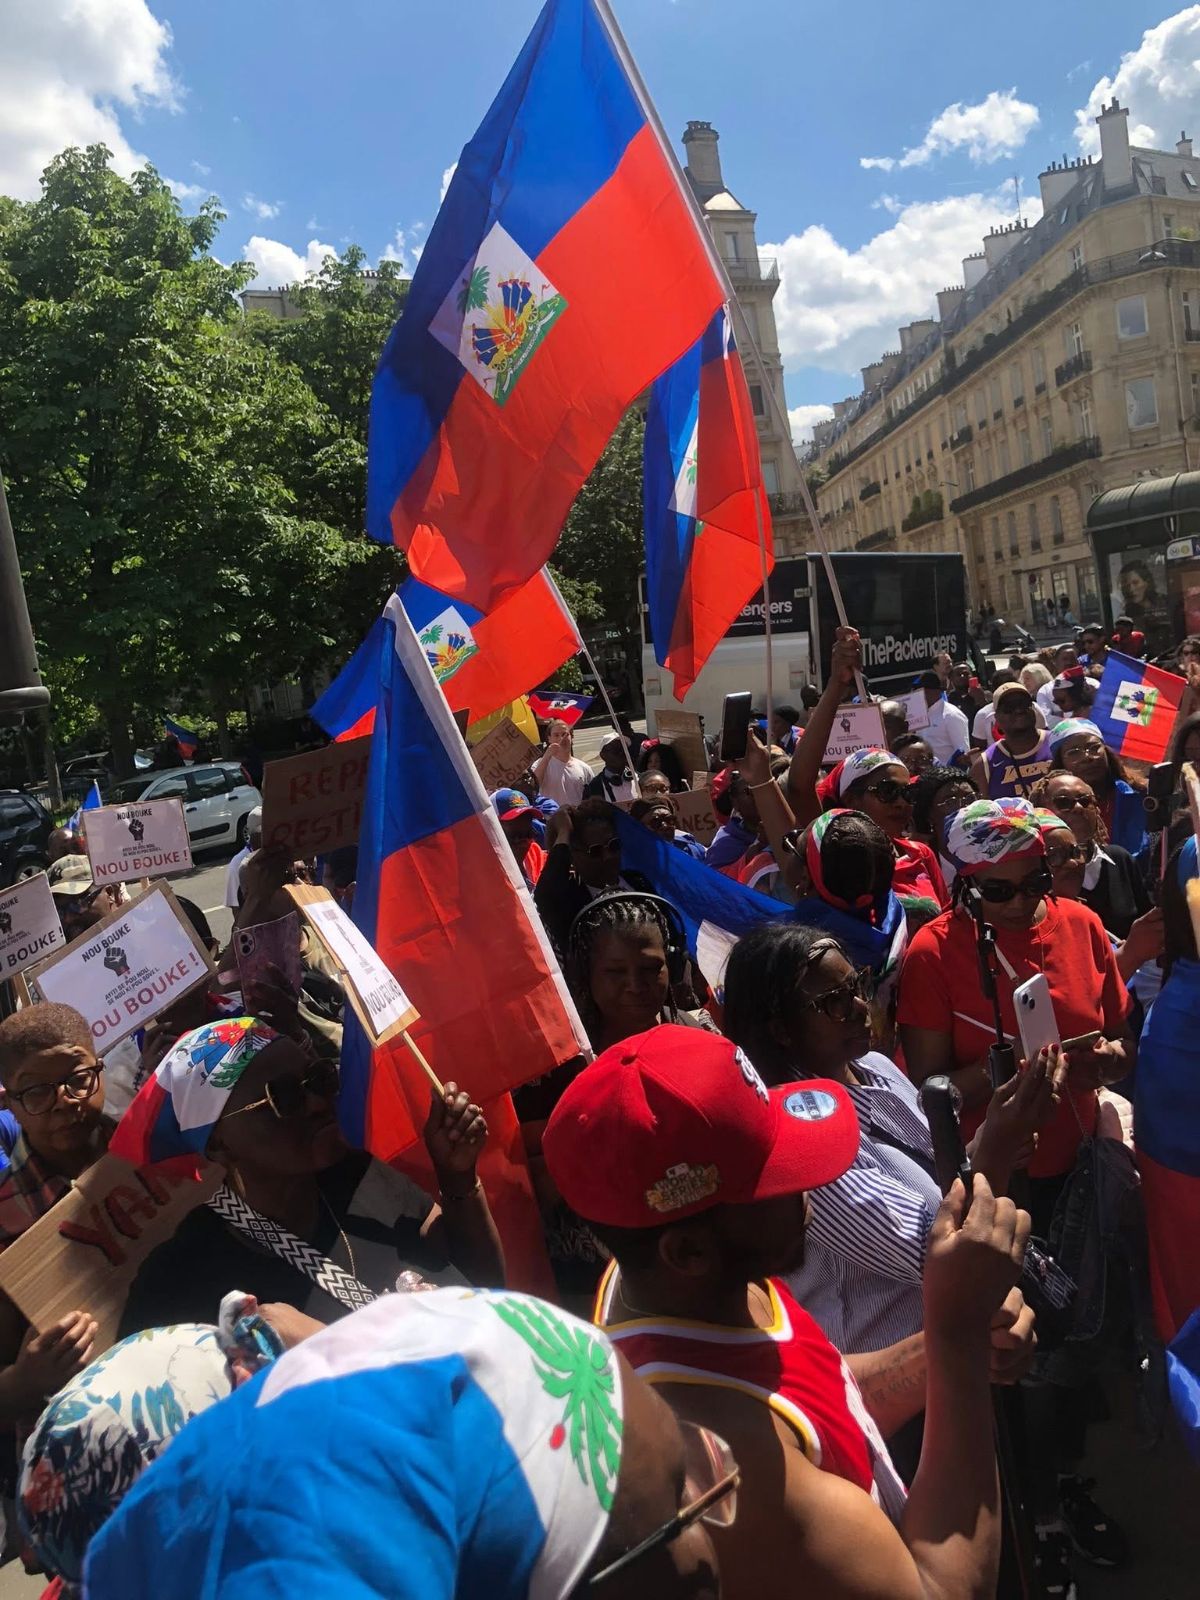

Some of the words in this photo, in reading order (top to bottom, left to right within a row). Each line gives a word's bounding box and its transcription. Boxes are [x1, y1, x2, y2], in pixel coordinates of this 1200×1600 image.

[131, 808, 152, 819] BOUKE
[96, 861, 129, 877] NOU
[133, 851, 180, 870] BOUKE
[184, 850, 188, 861] !
[7, 931, 57, 968] BOUKE
[59, 926, 64, 938] !
[81, 943, 102, 963] NOU
[101, 923, 132, 949] BOUKE
[91, 1008, 122, 1037] OU
[123, 959, 190, 1015] BOUKE
[189, 952, 199, 966] !
